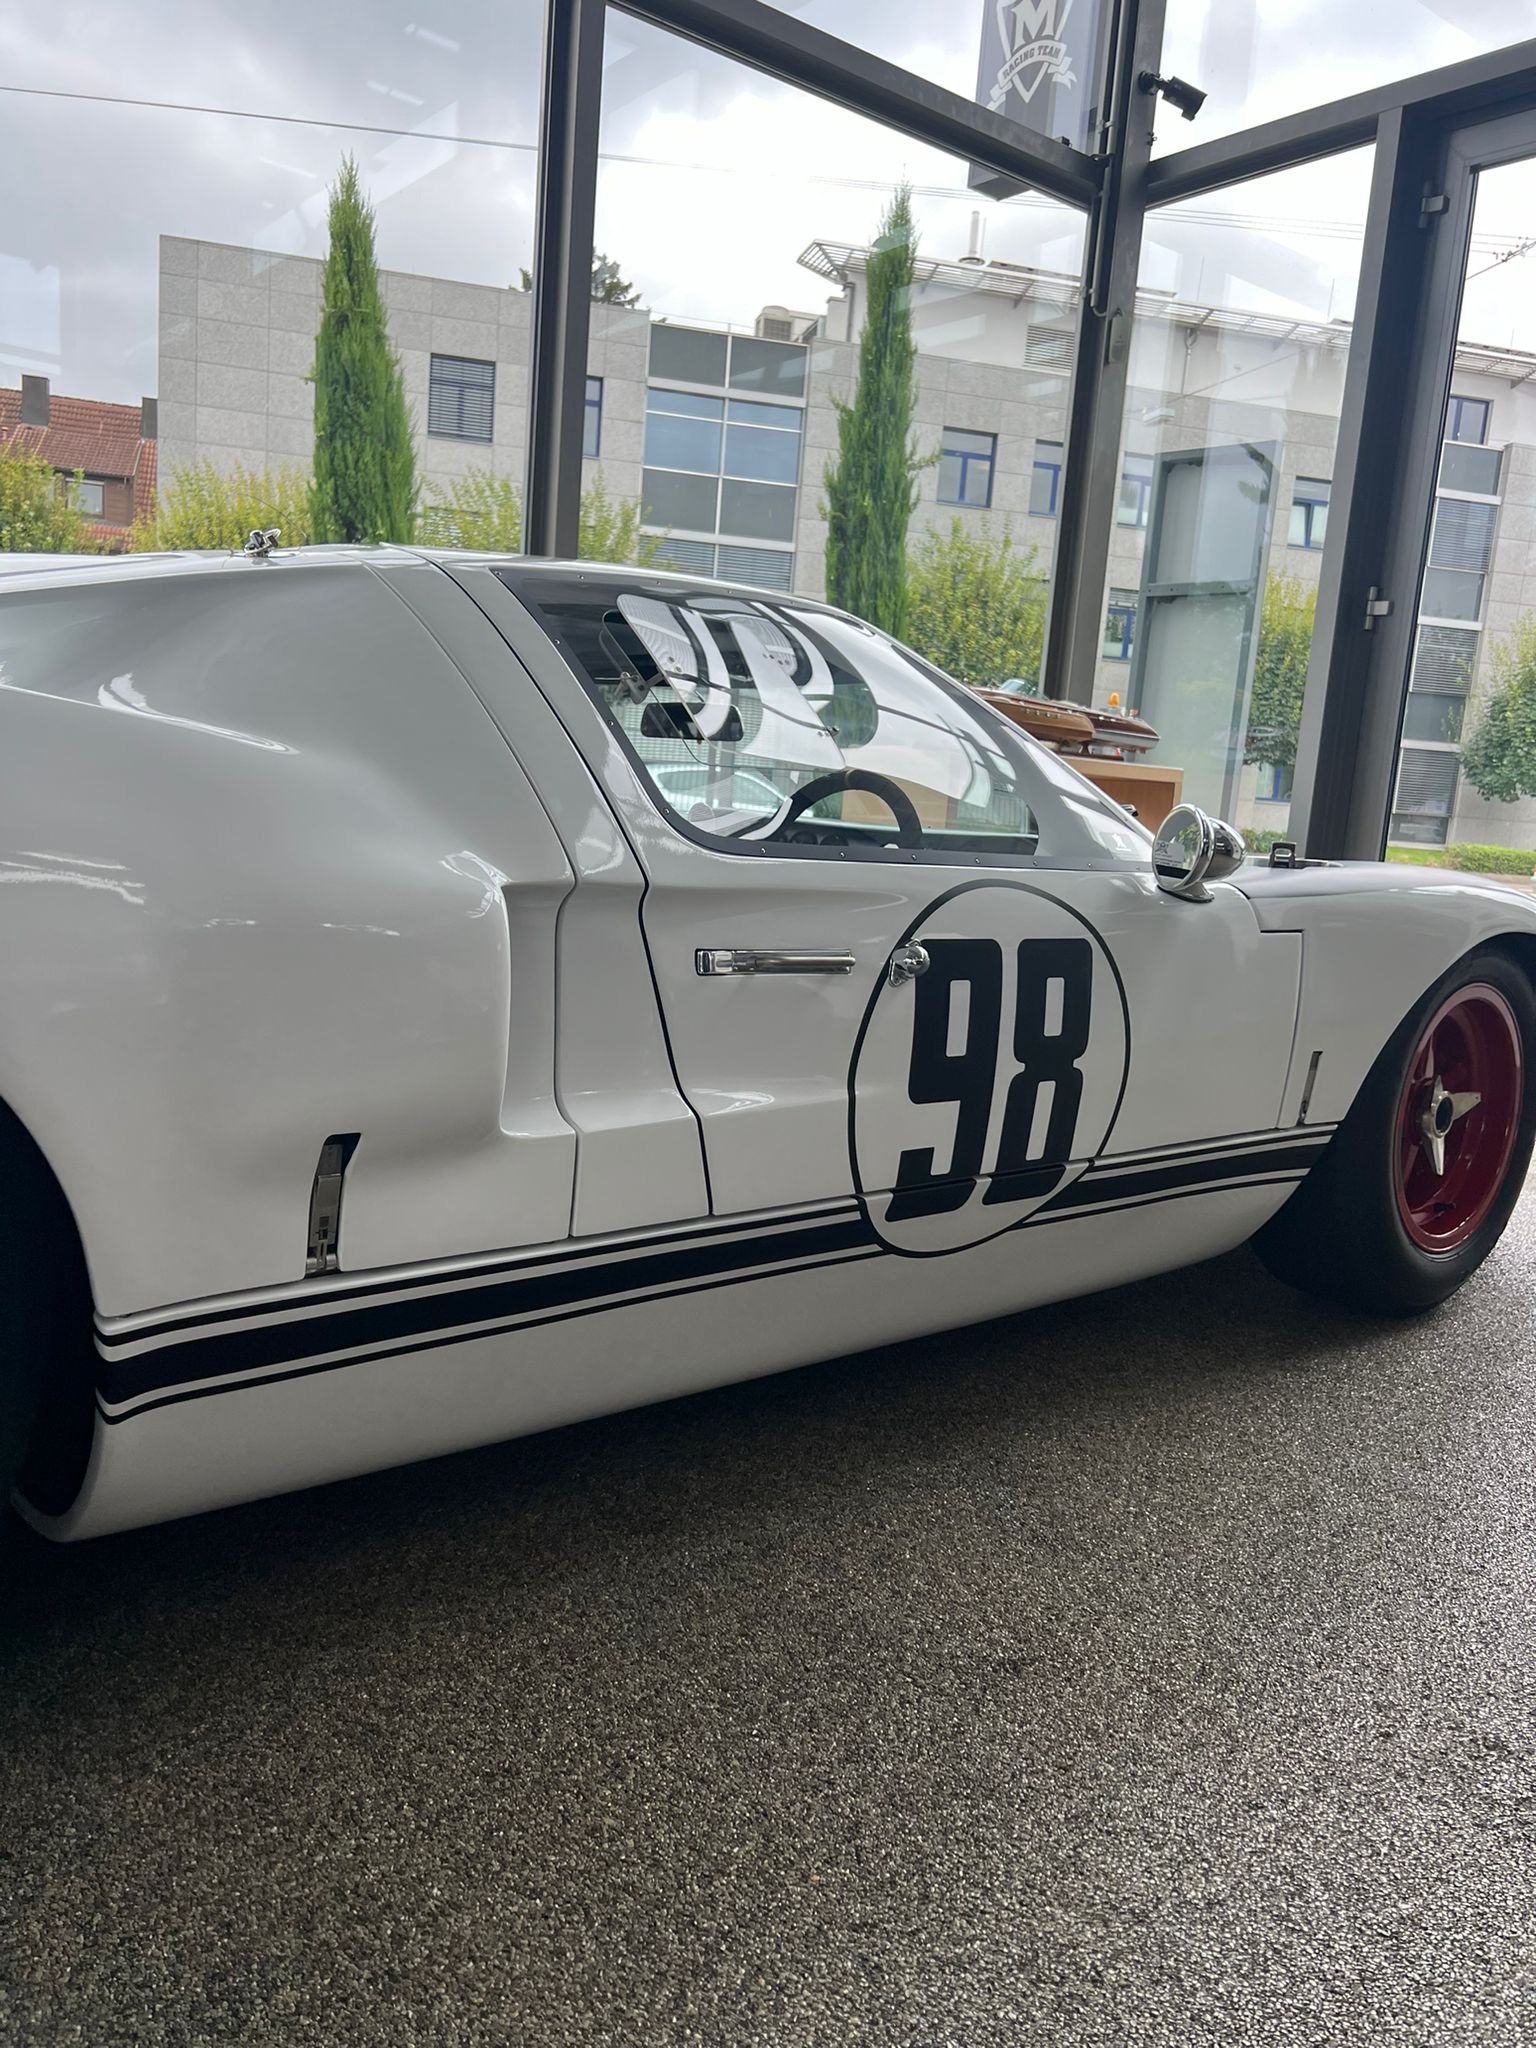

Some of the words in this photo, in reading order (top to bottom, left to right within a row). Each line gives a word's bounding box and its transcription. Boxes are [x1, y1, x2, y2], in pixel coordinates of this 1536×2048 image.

[1010, 0, 1056, 52] M
[1002, 48, 1035, 80] RACING
[1037, 45, 1061, 59] TEAM
[885, 938, 1093, 1222] 98
